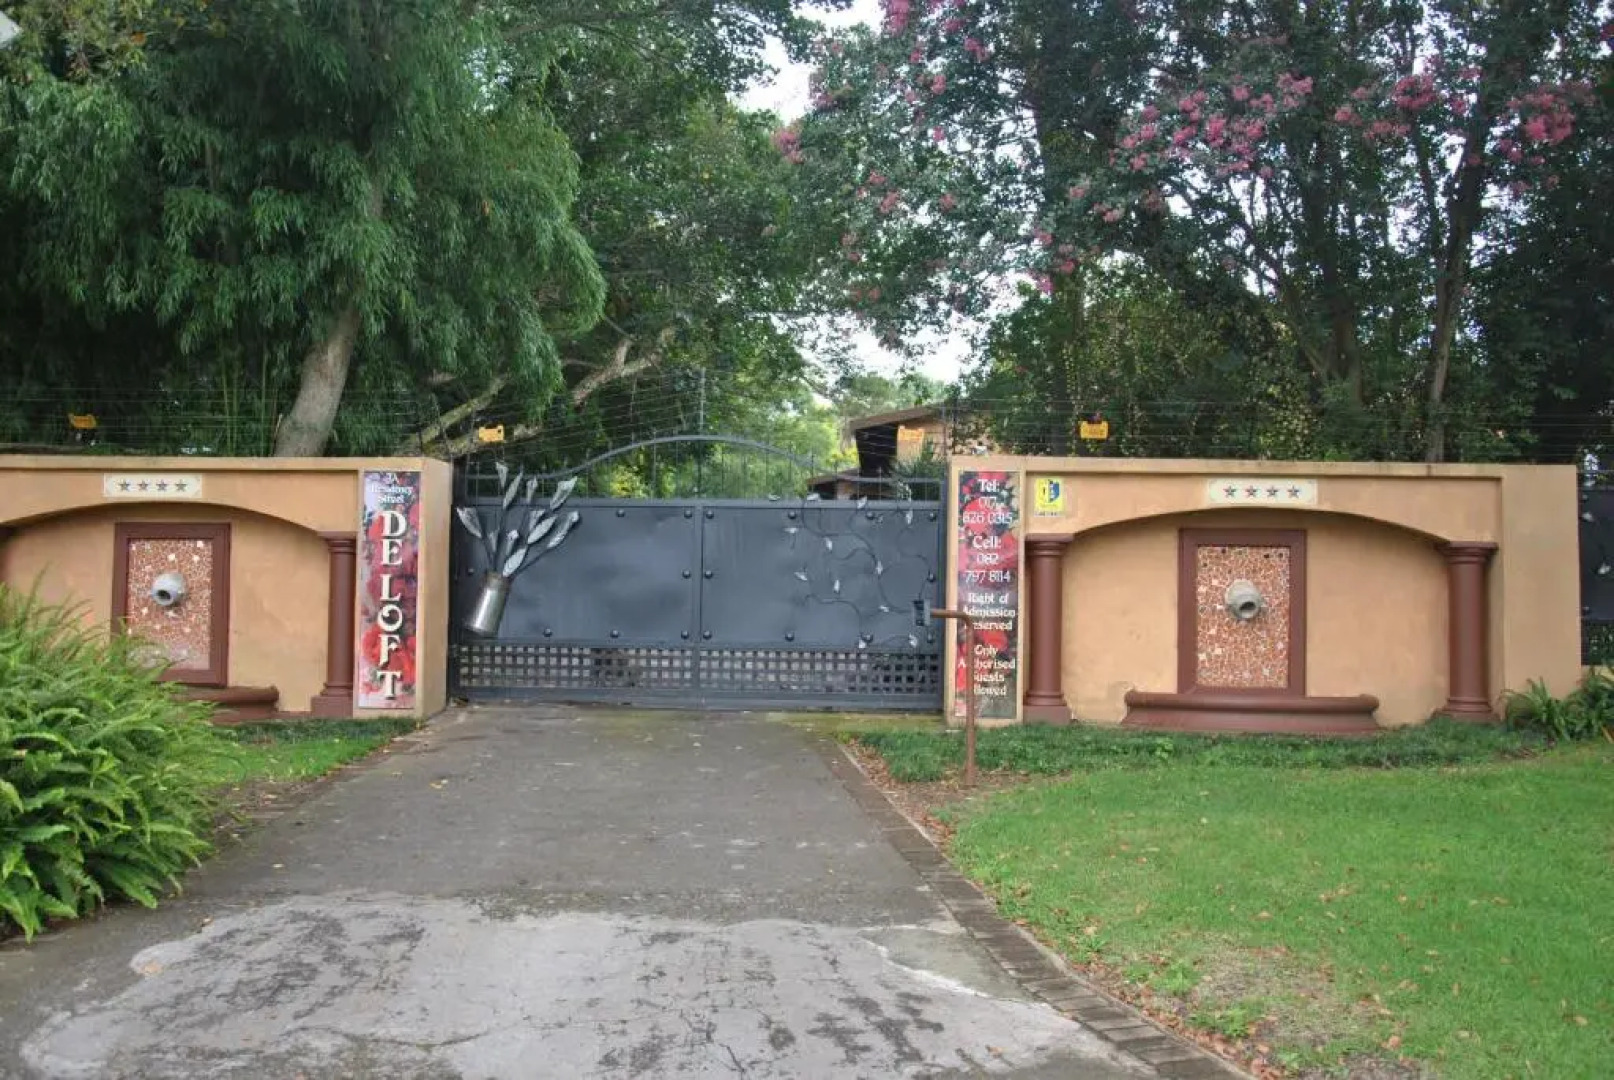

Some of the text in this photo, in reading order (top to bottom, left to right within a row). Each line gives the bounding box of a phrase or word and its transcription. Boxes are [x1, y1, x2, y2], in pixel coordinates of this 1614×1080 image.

[977, 479, 1000, 492] Tel:
[972, 535, 1002, 548] Cell:
[968, 592, 1009, 604] Right of
[964, 620, 1013, 631] eserved
[973, 644, 998, 658] Only
[973, 671, 1005, 682] uests
